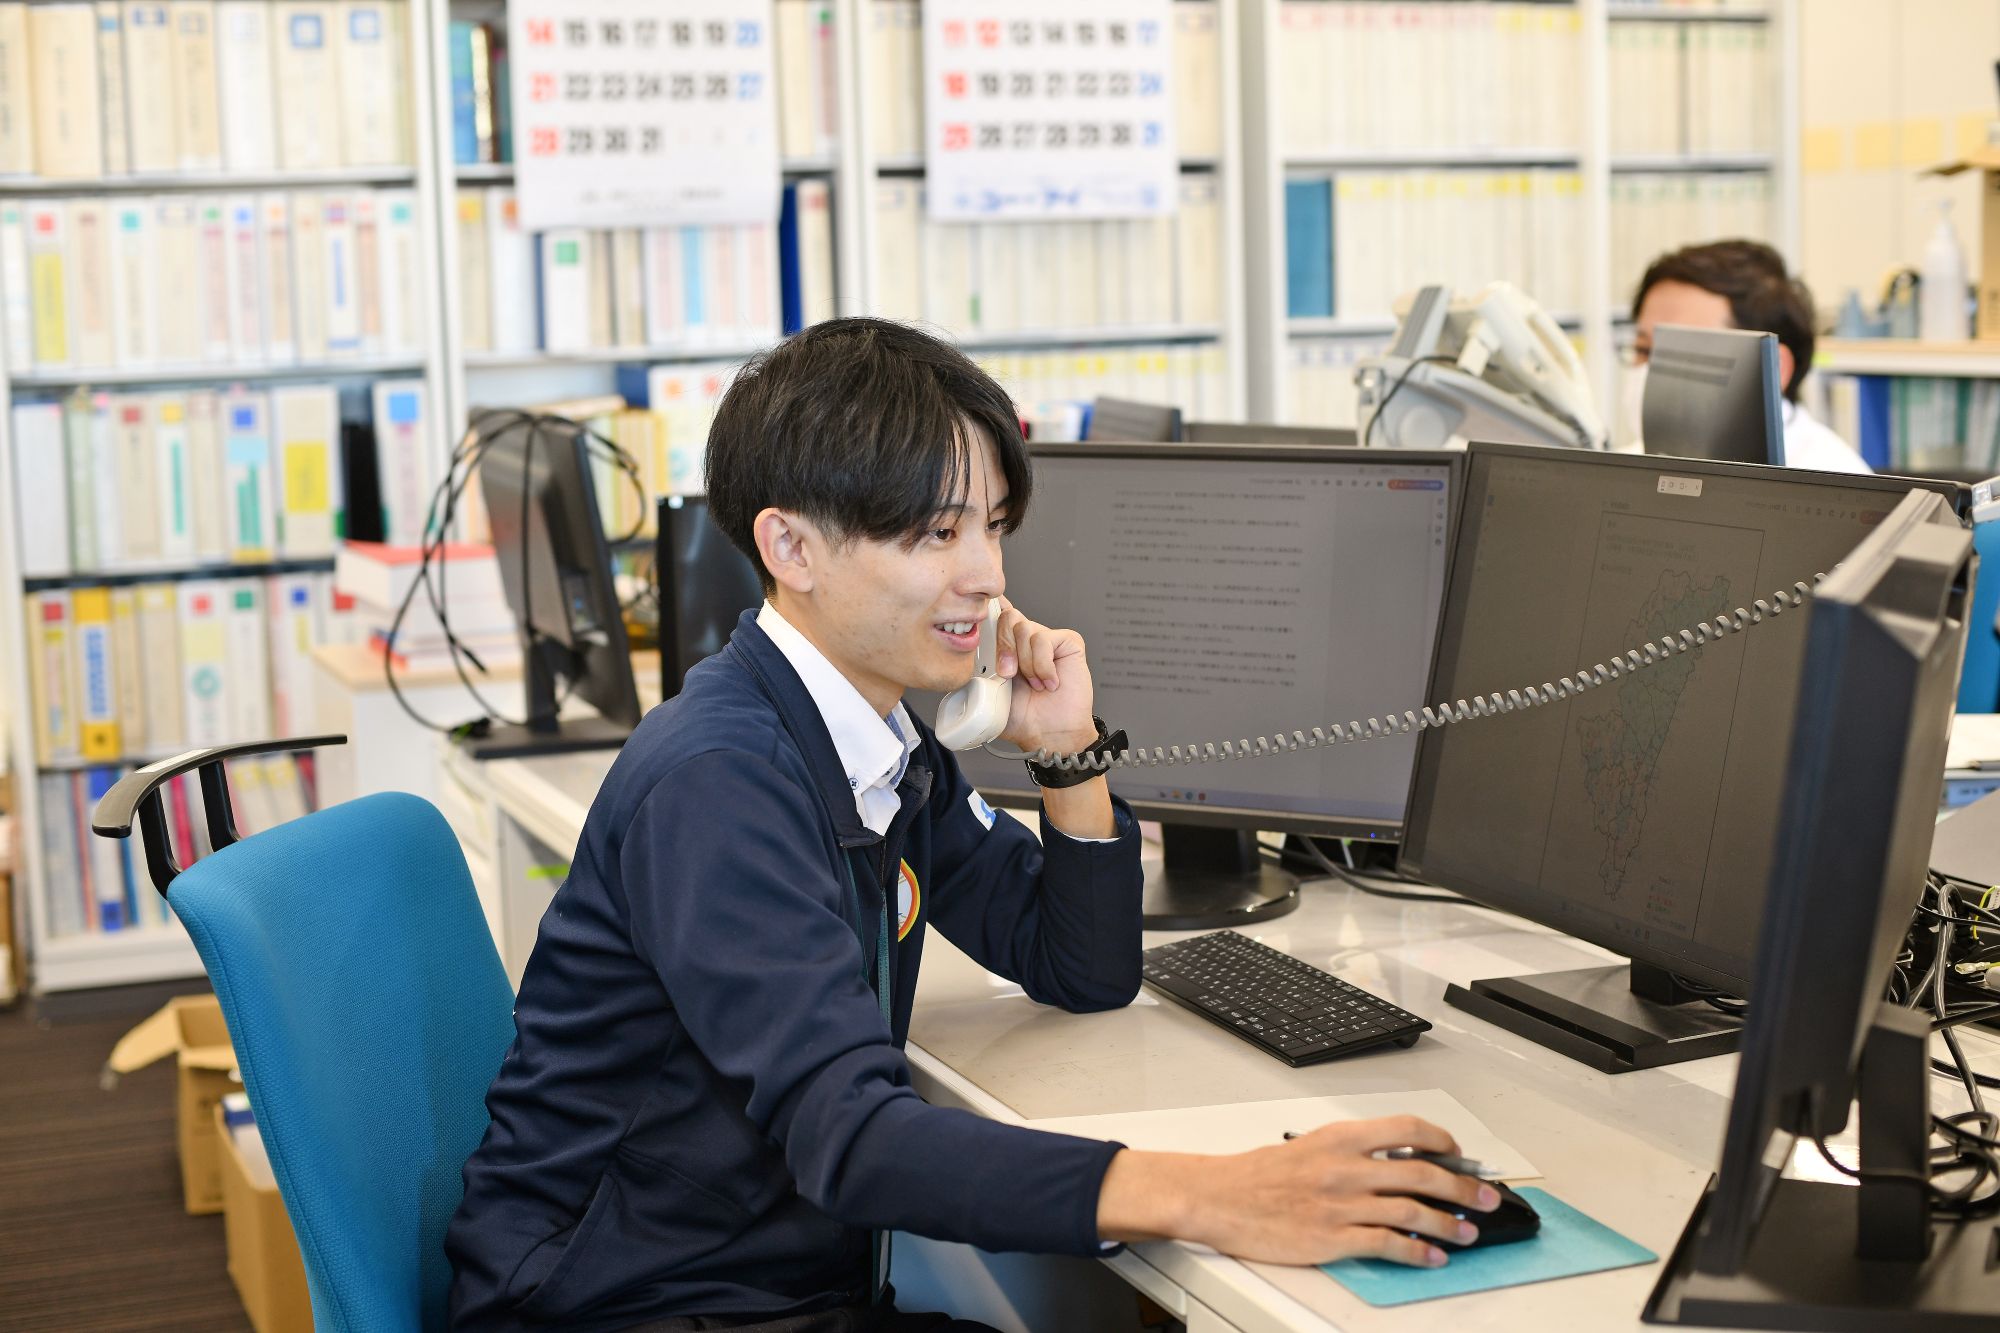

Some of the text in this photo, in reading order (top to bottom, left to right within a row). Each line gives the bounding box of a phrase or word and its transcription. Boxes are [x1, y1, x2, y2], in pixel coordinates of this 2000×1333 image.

[528, 18, 554, 46] 14
[565, 18, 588, 46] 15
[601, 18, 623, 46] 16
[670, 18, 692, 46] 18
[704, 18, 726, 46] 19
[944, 20, 967, 46] 11
[976, 20, 1001, 46] 12
[1043, 20, 1066, 46] 14
[1075, 20, 1097, 46] 15
[1108, 20, 1128, 46] 16
[1138, 20, 1159, 46] 17
[531, 72, 762, 100] 21 22 23 24 25 26 27
[944, 72, 969, 98] 18
[979, 72, 1001, 98] 19
[1011, 72, 1034, 98] 20
[1045, 72, 1066, 98] 21
[1108, 72, 1132, 98] 23
[1138, 72, 1163, 98] 24
[568, 127, 595, 154] 29
[604, 127, 629, 154] 30
[641, 127, 661, 154] 31
[944, 122, 973, 150] 25
[979, 122, 1004, 150] 26
[1013, 122, 1037, 150] 27
[1045, 122, 1069, 150] 28
[1077, 122, 1101, 150] 29
[1110, 122, 1132, 150] 30
